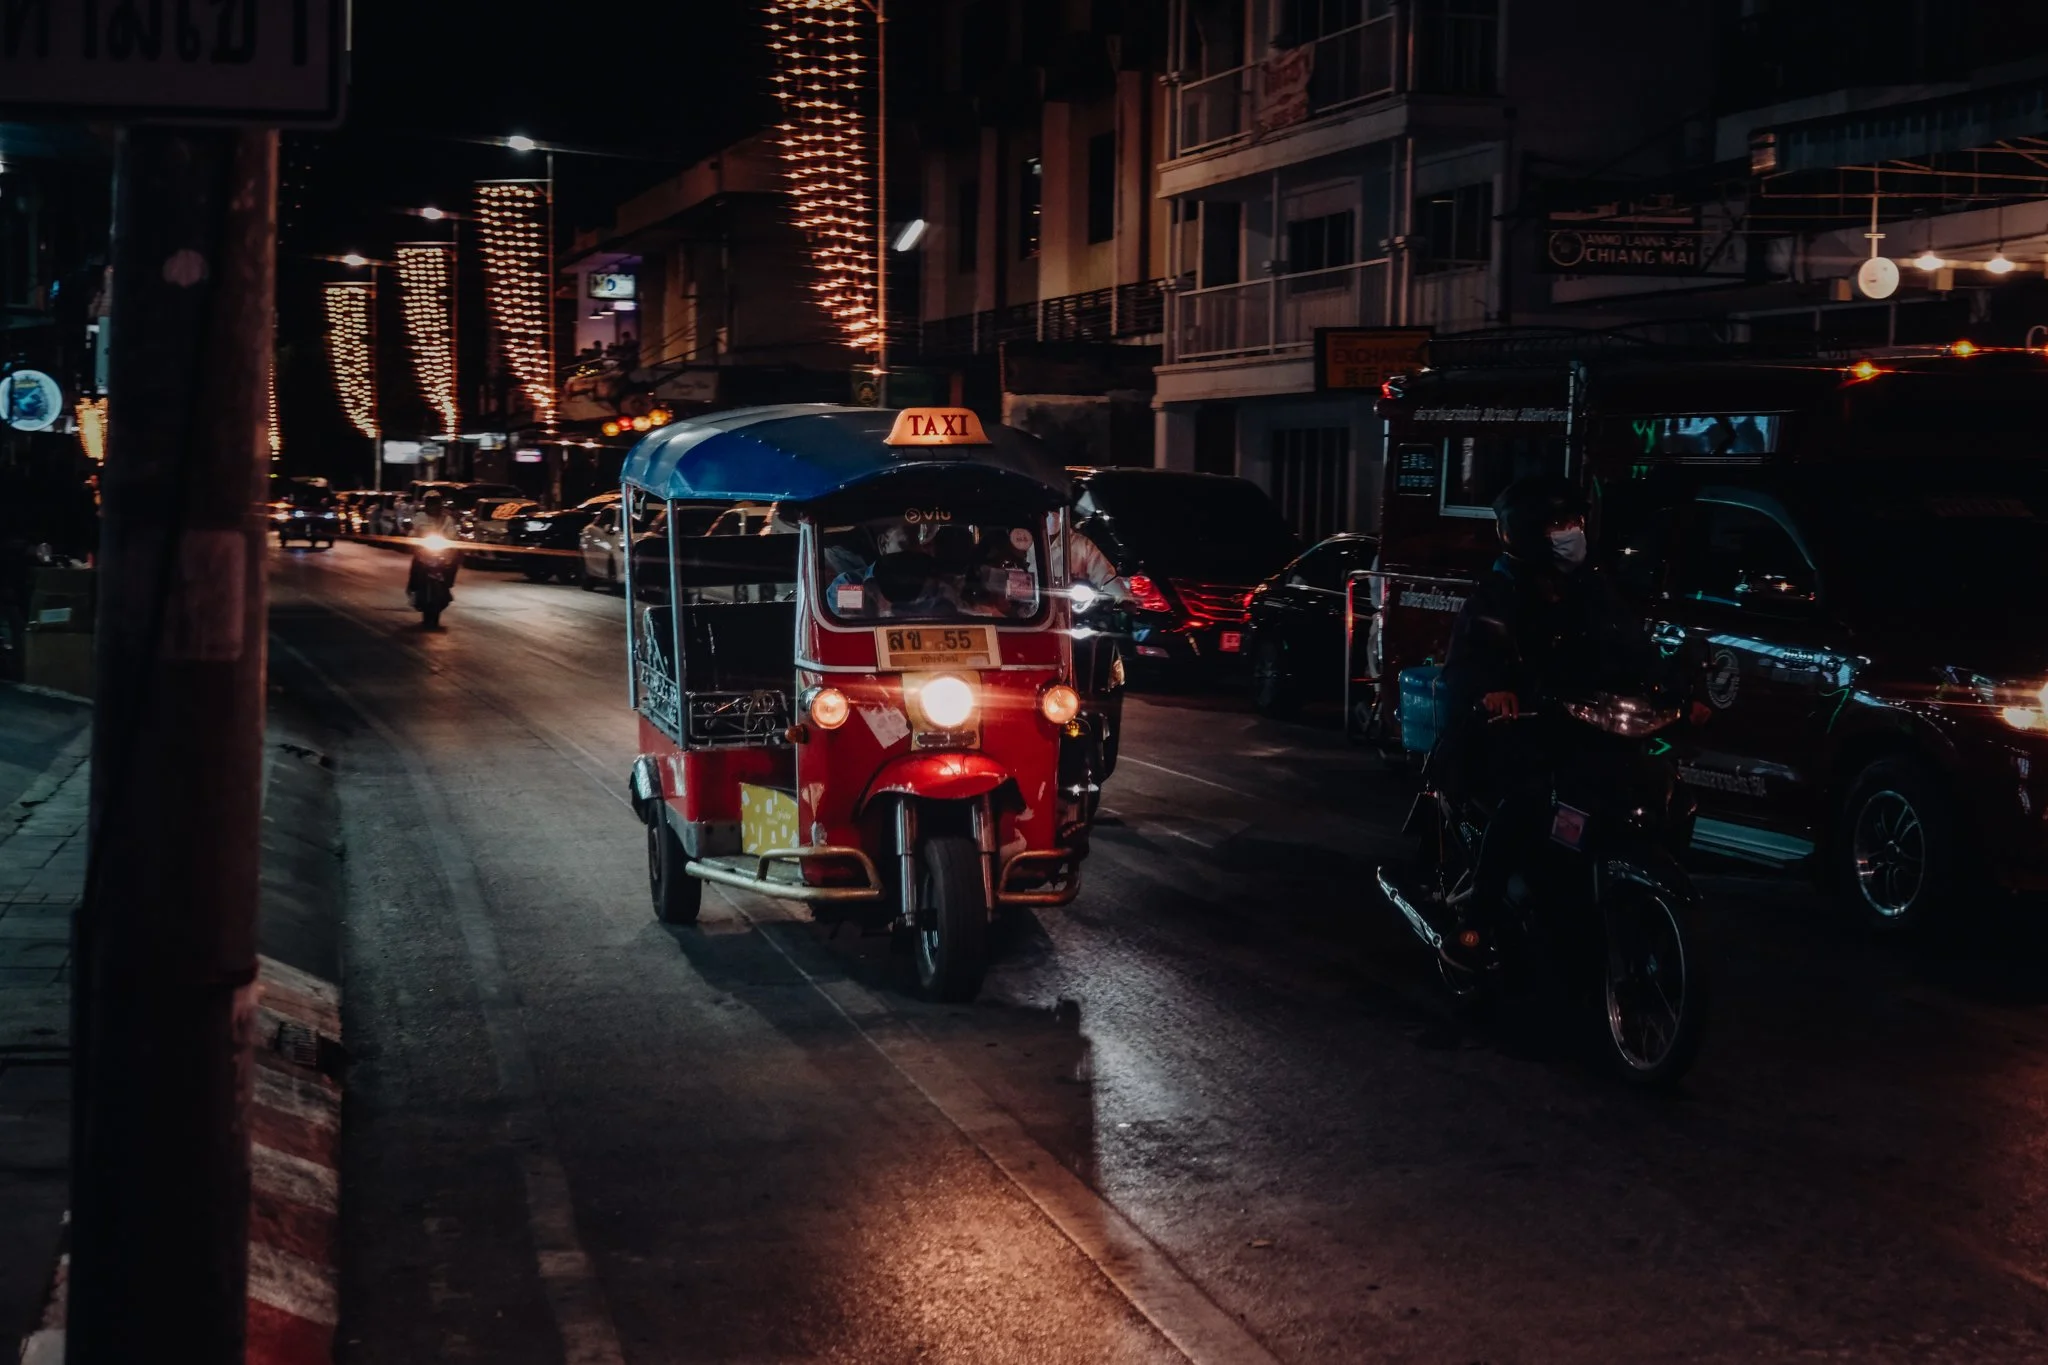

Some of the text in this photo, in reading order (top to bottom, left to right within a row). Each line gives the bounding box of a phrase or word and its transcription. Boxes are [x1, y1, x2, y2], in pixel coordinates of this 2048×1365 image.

[1671, 237, 1695, 248] SPA
[1586, 248, 1695, 265] CHIANG MAI
[907, 414, 969, 436] TAXI
[922, 506, 952, 520] viu
[944, 630, 971, 650] 55
